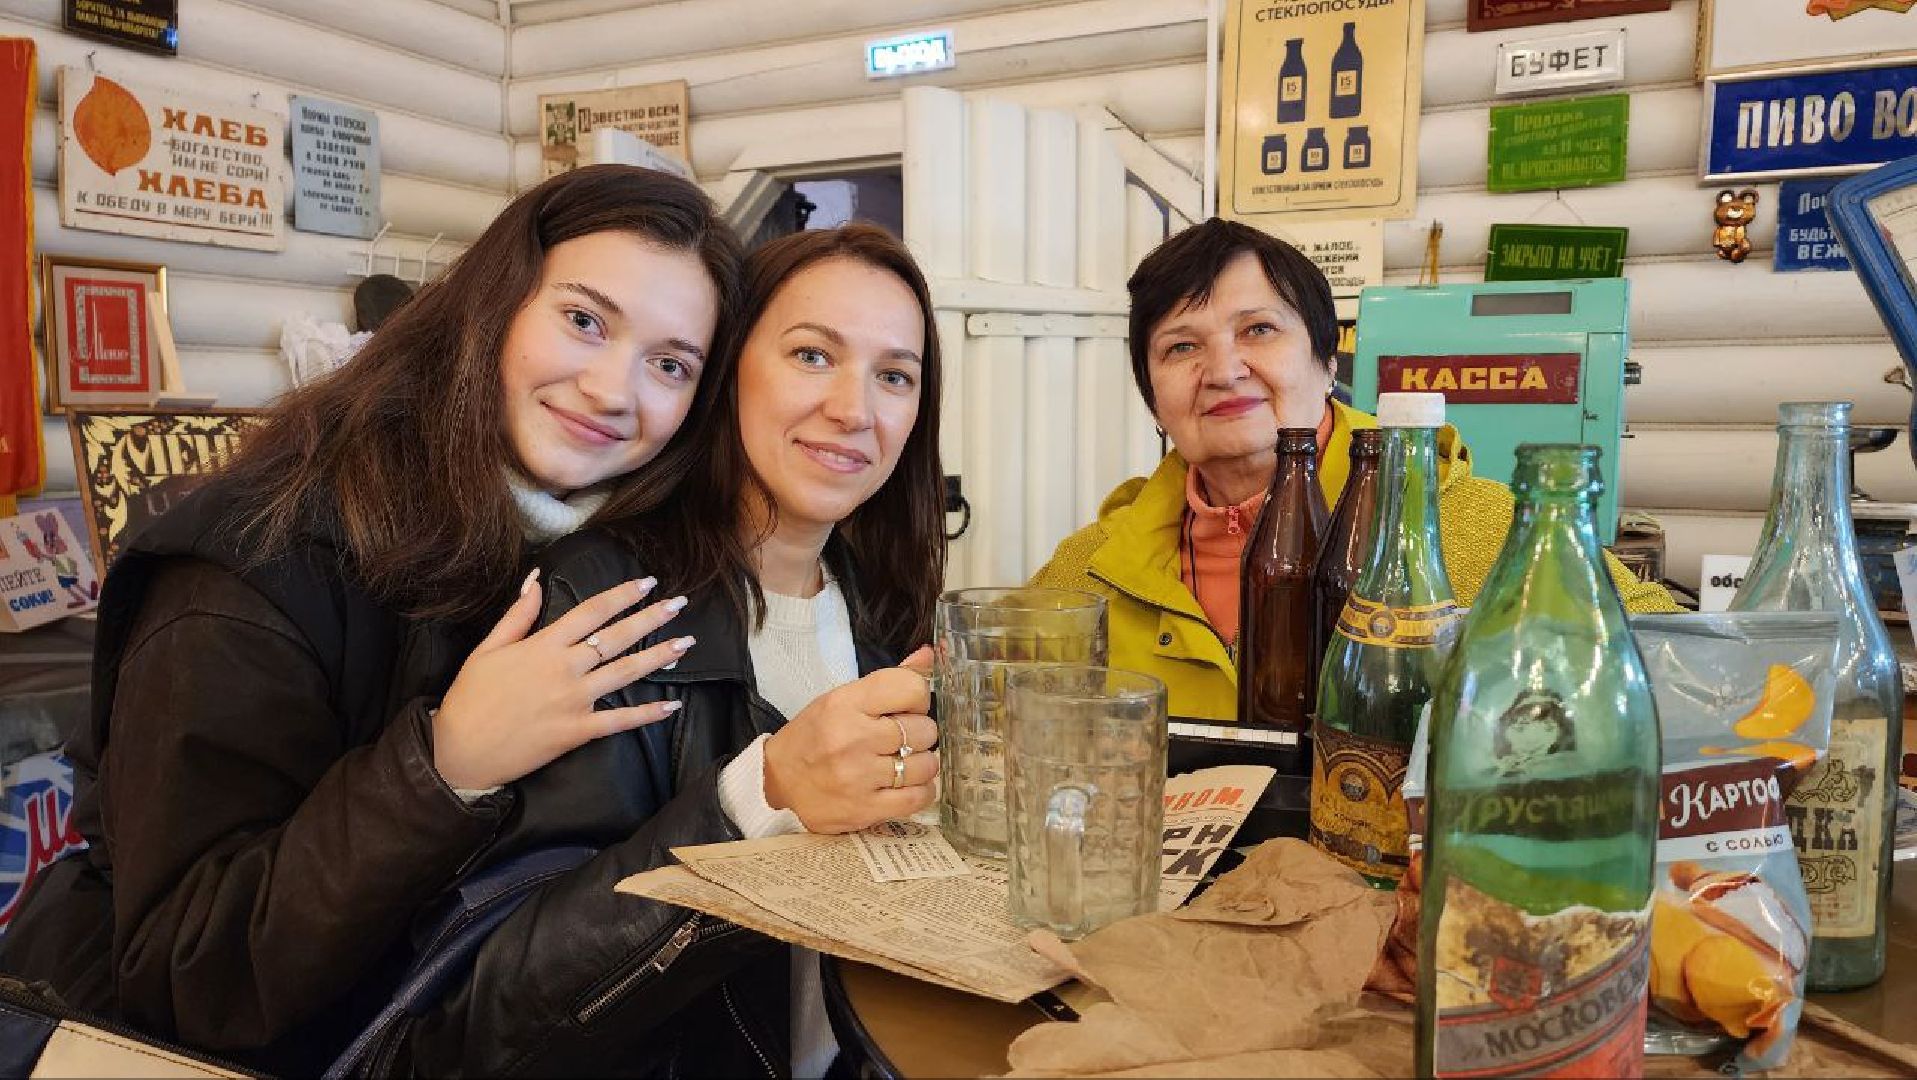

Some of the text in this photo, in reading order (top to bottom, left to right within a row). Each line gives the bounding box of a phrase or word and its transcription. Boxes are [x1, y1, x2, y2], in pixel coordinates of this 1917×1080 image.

[1511, 45, 1608, 77] БУФЕТ
[163, 106, 268, 146] ХЛЕБ
[1737, 86, 1917, 149] ПИВО ВО
[172, 153, 269, 182] ИМ НЕ СОРИ!
[138, 169, 267, 209] ХЛЕБА
[77, 190, 89, 203] К
[96, 193, 150, 212] ОБЕДУ
[157, 202, 167, 216] В
[173, 204, 210, 221] МЕРУ
[1502, 243, 1554, 269] ЗАКРЫТО
[1557, 245, 1576, 269] НА
[1797, 244, 1849, 260] ВЕЖ
[1402, 366, 1548, 390] КАССА
